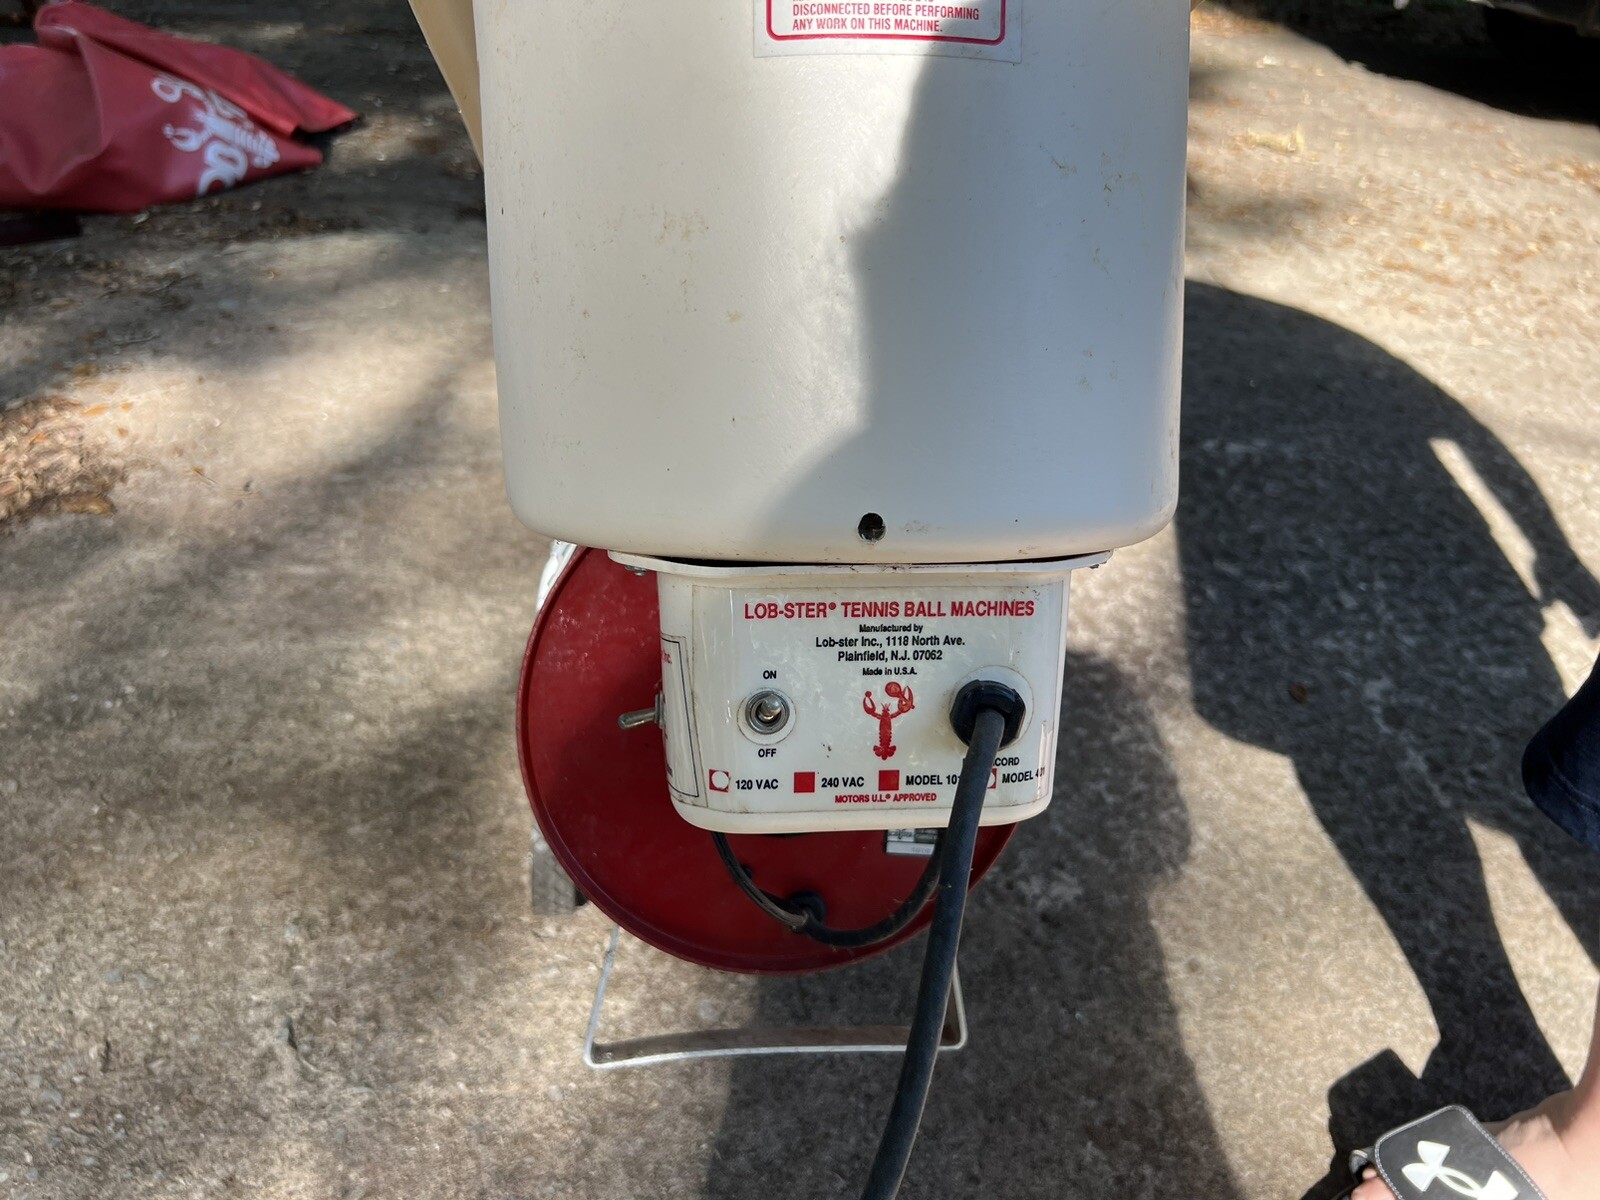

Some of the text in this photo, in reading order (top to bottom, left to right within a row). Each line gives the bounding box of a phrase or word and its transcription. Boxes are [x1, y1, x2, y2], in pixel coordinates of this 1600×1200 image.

[793, 3, 980, 20] DISCONNECTED BEFORE PERFORMING
[792, 17, 943, 32] ANY WORK ON THIS MACHINE.
[840, 602, 900, 618] TENNIS
[904, 601, 946, 617] BALL
[950, 600, 1035, 617] MACHINES
[859, 623, 924, 634] Manufactured by
[816, 635, 966, 649] Lob-ster Inc., 1118 North Ave.
[838, 650, 943, 663] Plainfield, N.J. 07062
[763, 670, 777, 679] ON
[862, 667, 918, 676] Made in U.S.A.
[758, 748, 777, 758] OFF
[821, 777, 865, 788] 240 VAC
[906, 774, 943, 786] MODEL
[1002, 770, 1034, 784] MODEL
[735, 779, 779, 790] 120 VAC
[835, 794, 870, 803] MOTORS
[893, 793, 937, 802] APPROVED
